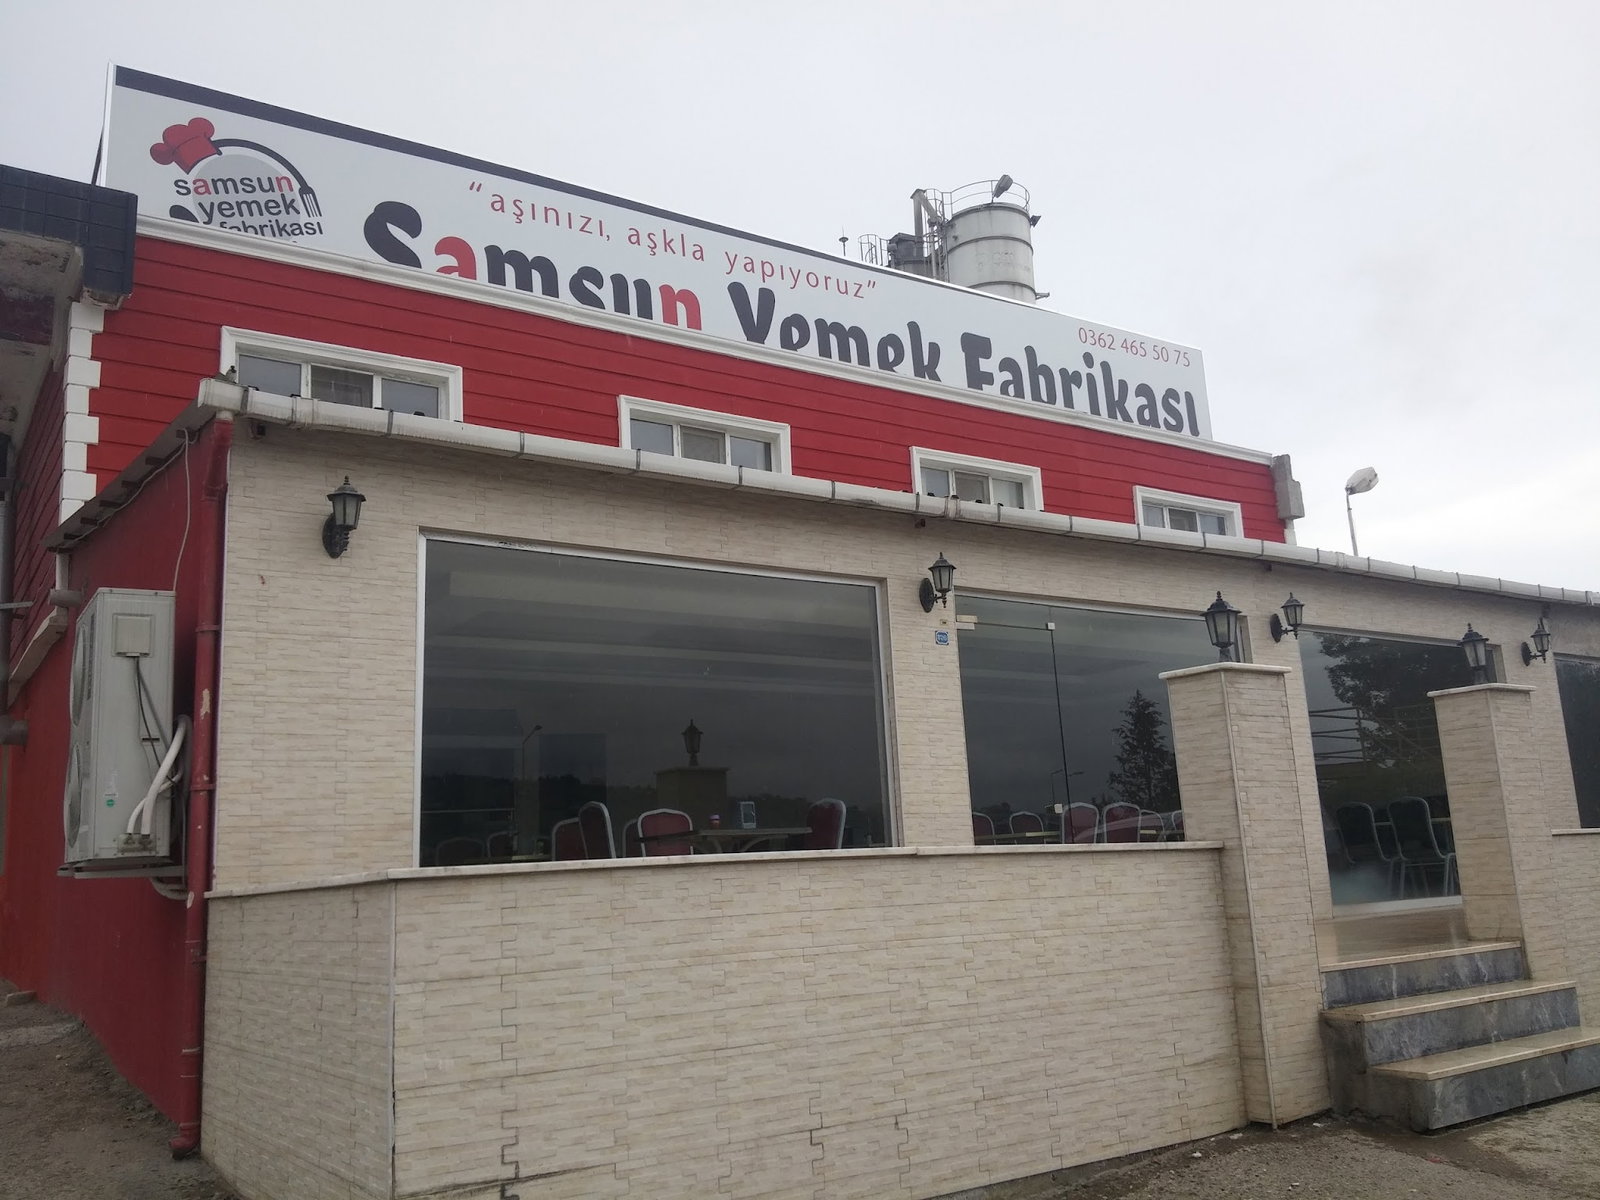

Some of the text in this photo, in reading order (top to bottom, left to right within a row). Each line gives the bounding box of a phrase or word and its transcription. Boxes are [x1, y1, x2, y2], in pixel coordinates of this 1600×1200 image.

[173, 175, 294, 196] samsun
[197, 193, 301, 225] yemek
[627, 226, 705, 261] aşkla
[363, 200, 1200, 437] Samsun Yemek Fabrikası
[1078, 326, 1190, 368] 0362 465 50 75
